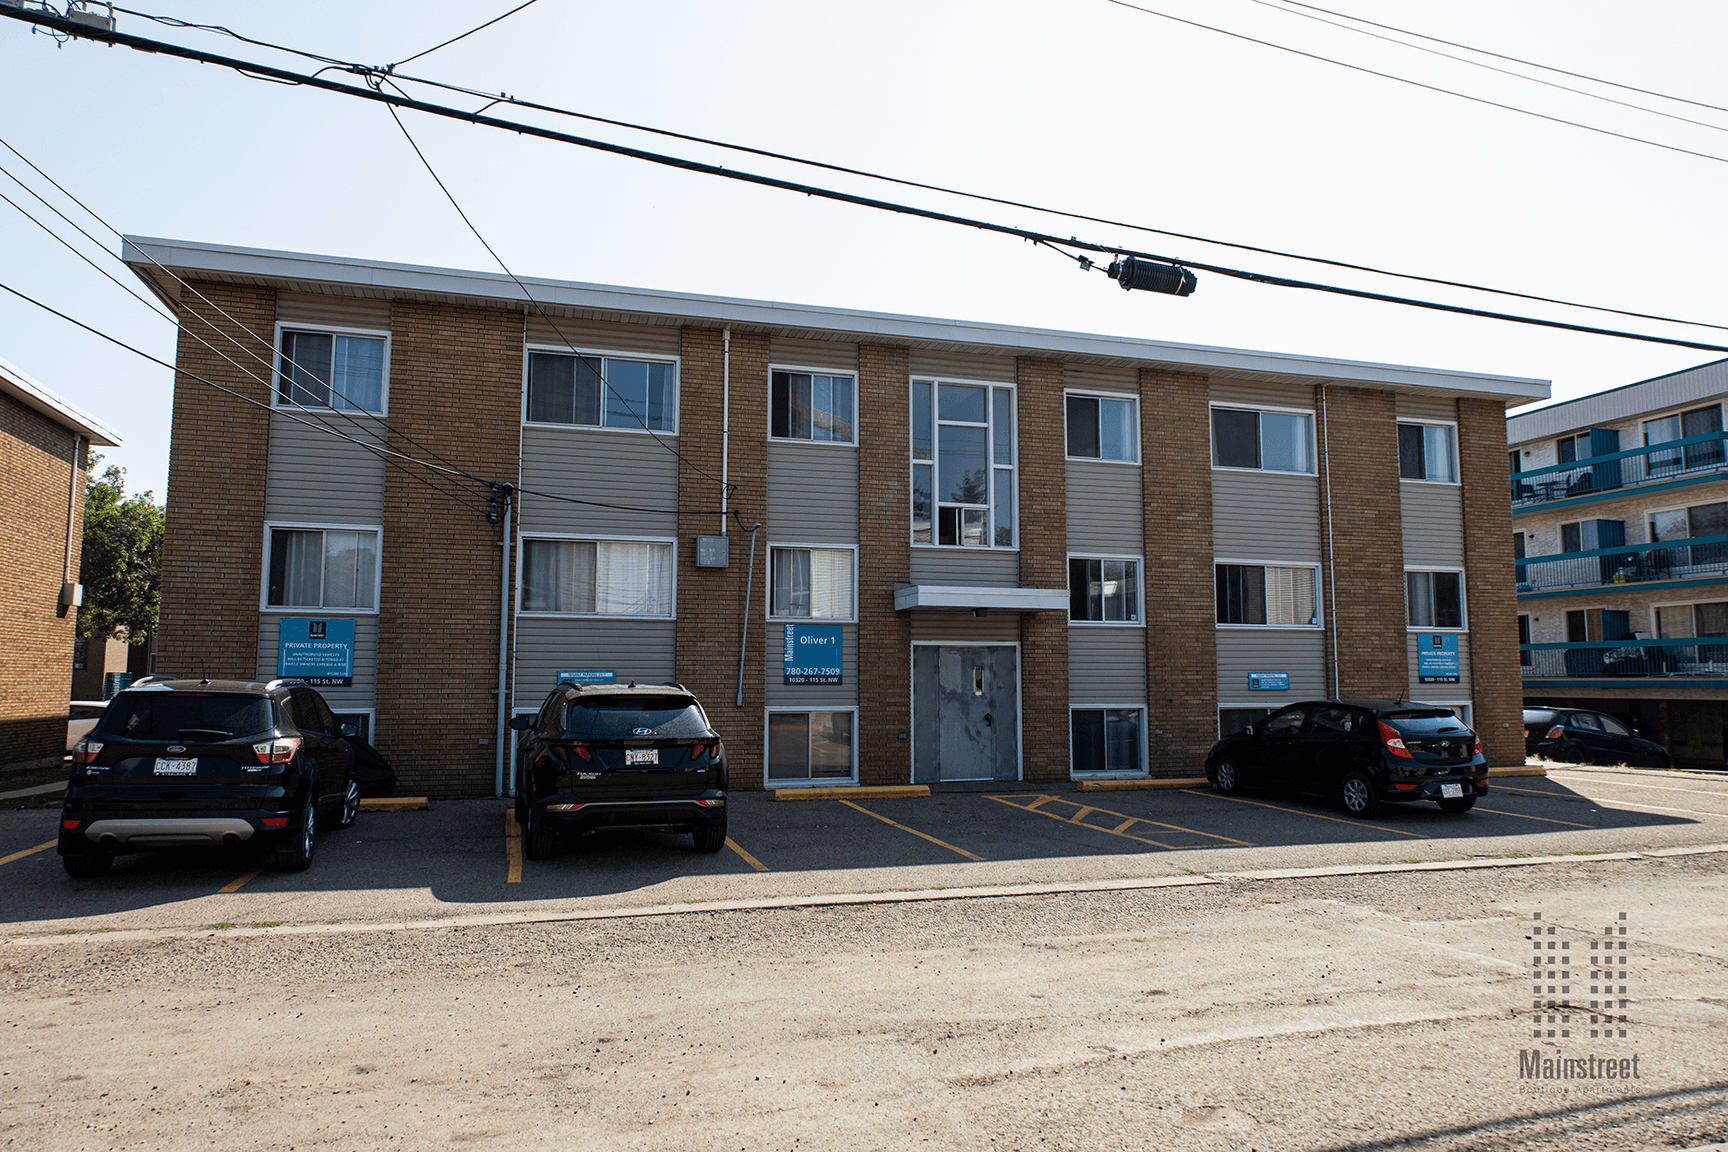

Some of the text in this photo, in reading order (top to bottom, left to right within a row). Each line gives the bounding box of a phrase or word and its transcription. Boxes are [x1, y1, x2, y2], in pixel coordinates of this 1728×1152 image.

[784, 624, 794, 662] Mainstreet
[800, 635, 835, 645] Oliver 1
[313, 642, 348, 650] PROPERTY
[786, 667, 840, 676] 780-267-7509
[155, 761, 197, 771] CCK-4387
